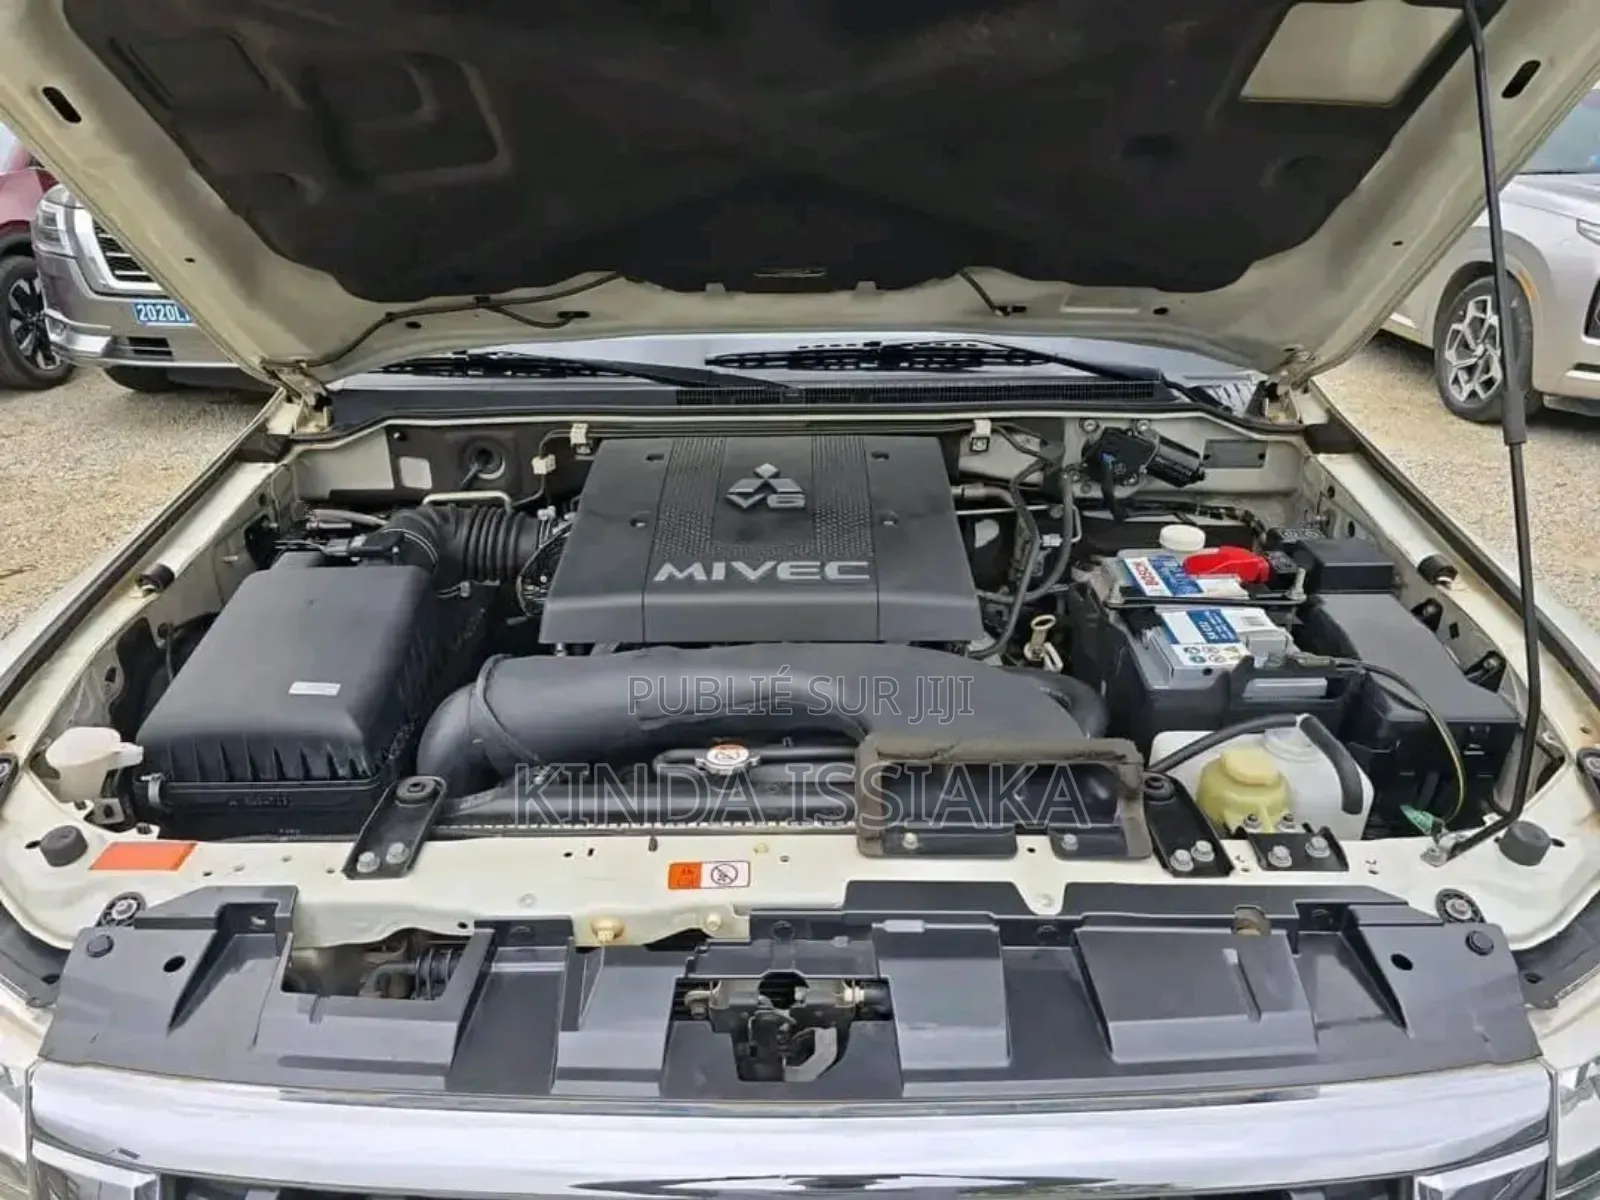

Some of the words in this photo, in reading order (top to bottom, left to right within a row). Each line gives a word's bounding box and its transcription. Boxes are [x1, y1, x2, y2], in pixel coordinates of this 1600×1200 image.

[137, 304, 190, 321] 2020L
[727, 493, 806, 508] V6
[653, 561, 870, 581] MIVEC
